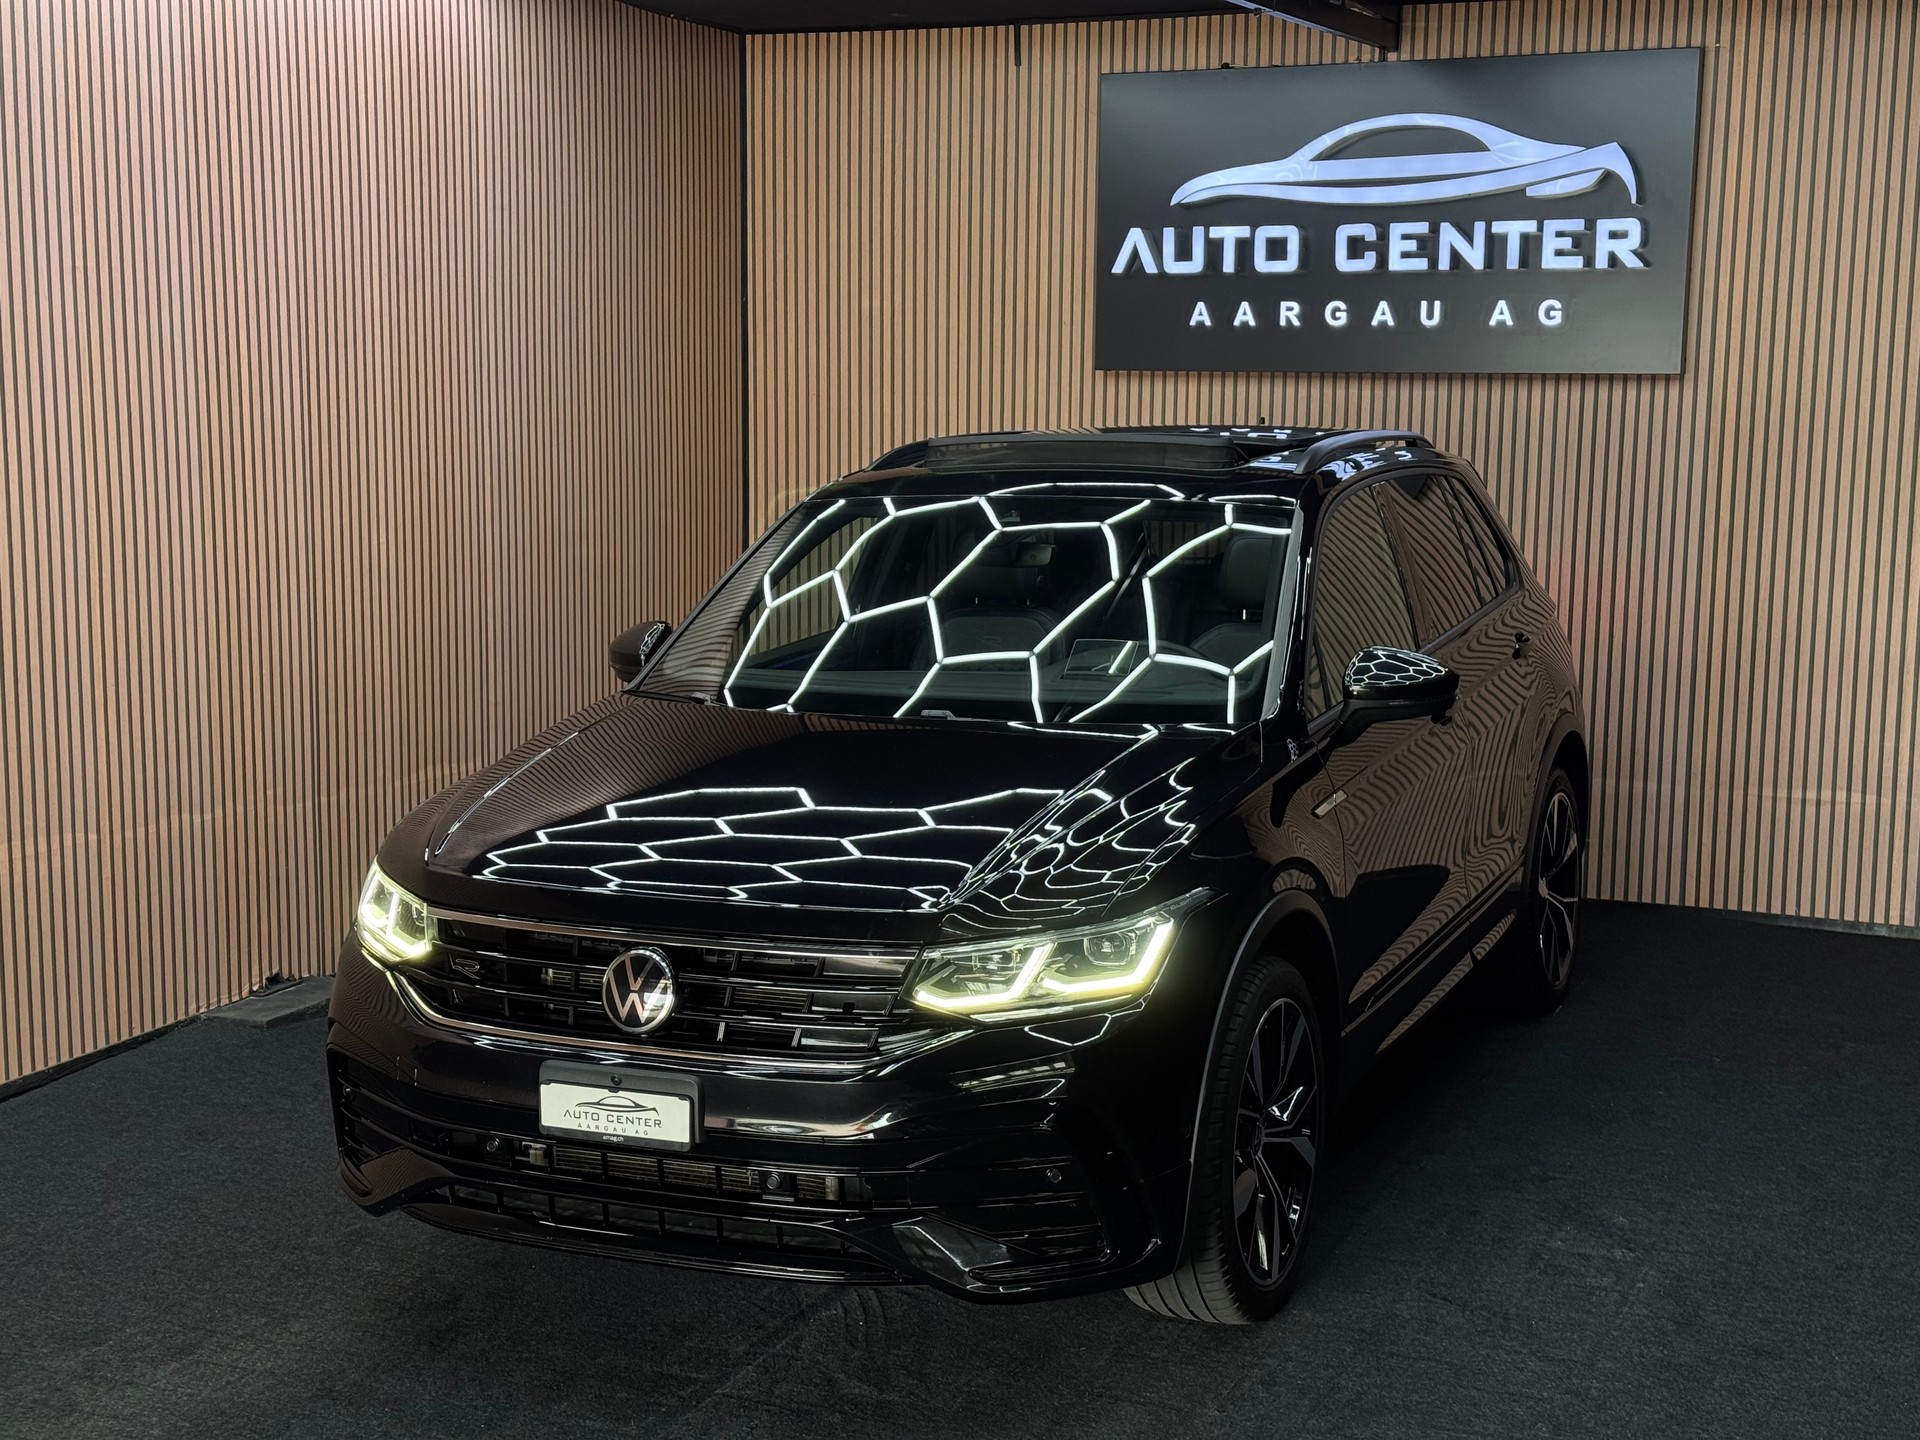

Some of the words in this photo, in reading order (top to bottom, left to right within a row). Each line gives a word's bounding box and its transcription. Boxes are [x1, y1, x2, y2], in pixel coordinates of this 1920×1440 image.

[1111, 224, 1301, 274] AUTO
[1335, 217, 1646, 272] CENTER
[1189, 299, 1441, 328] AARGAU
[1488, 299, 1564, 327] AG
[563, 1109, 600, 1121] AUTO
[606, 1114, 662, 1128] CENTER
[577, 1122, 626, 1133] AARGAU
